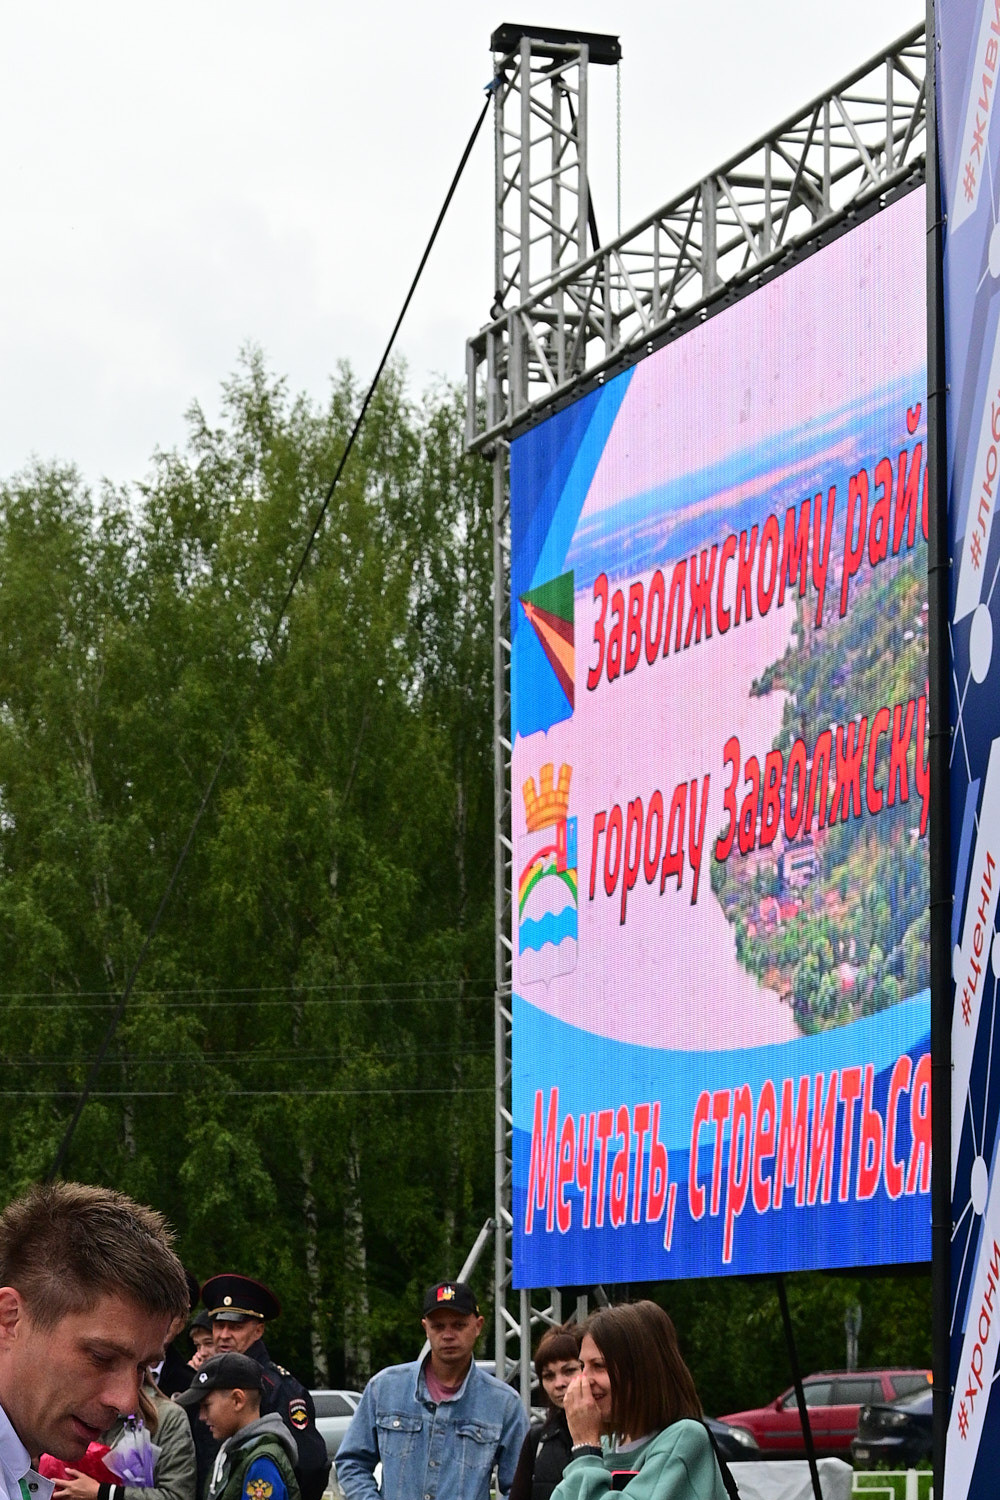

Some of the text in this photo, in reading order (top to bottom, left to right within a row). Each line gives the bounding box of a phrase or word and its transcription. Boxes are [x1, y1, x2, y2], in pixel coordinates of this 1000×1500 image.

[587, 402, 929, 691] Заволжскому рай
[970, 388, 1000, 571] #люб
[589, 773, 711, 926] городу
[961, 850, 996, 1027] #цени
[525, 1053, 931, 1263] Мечтать, стремиться
